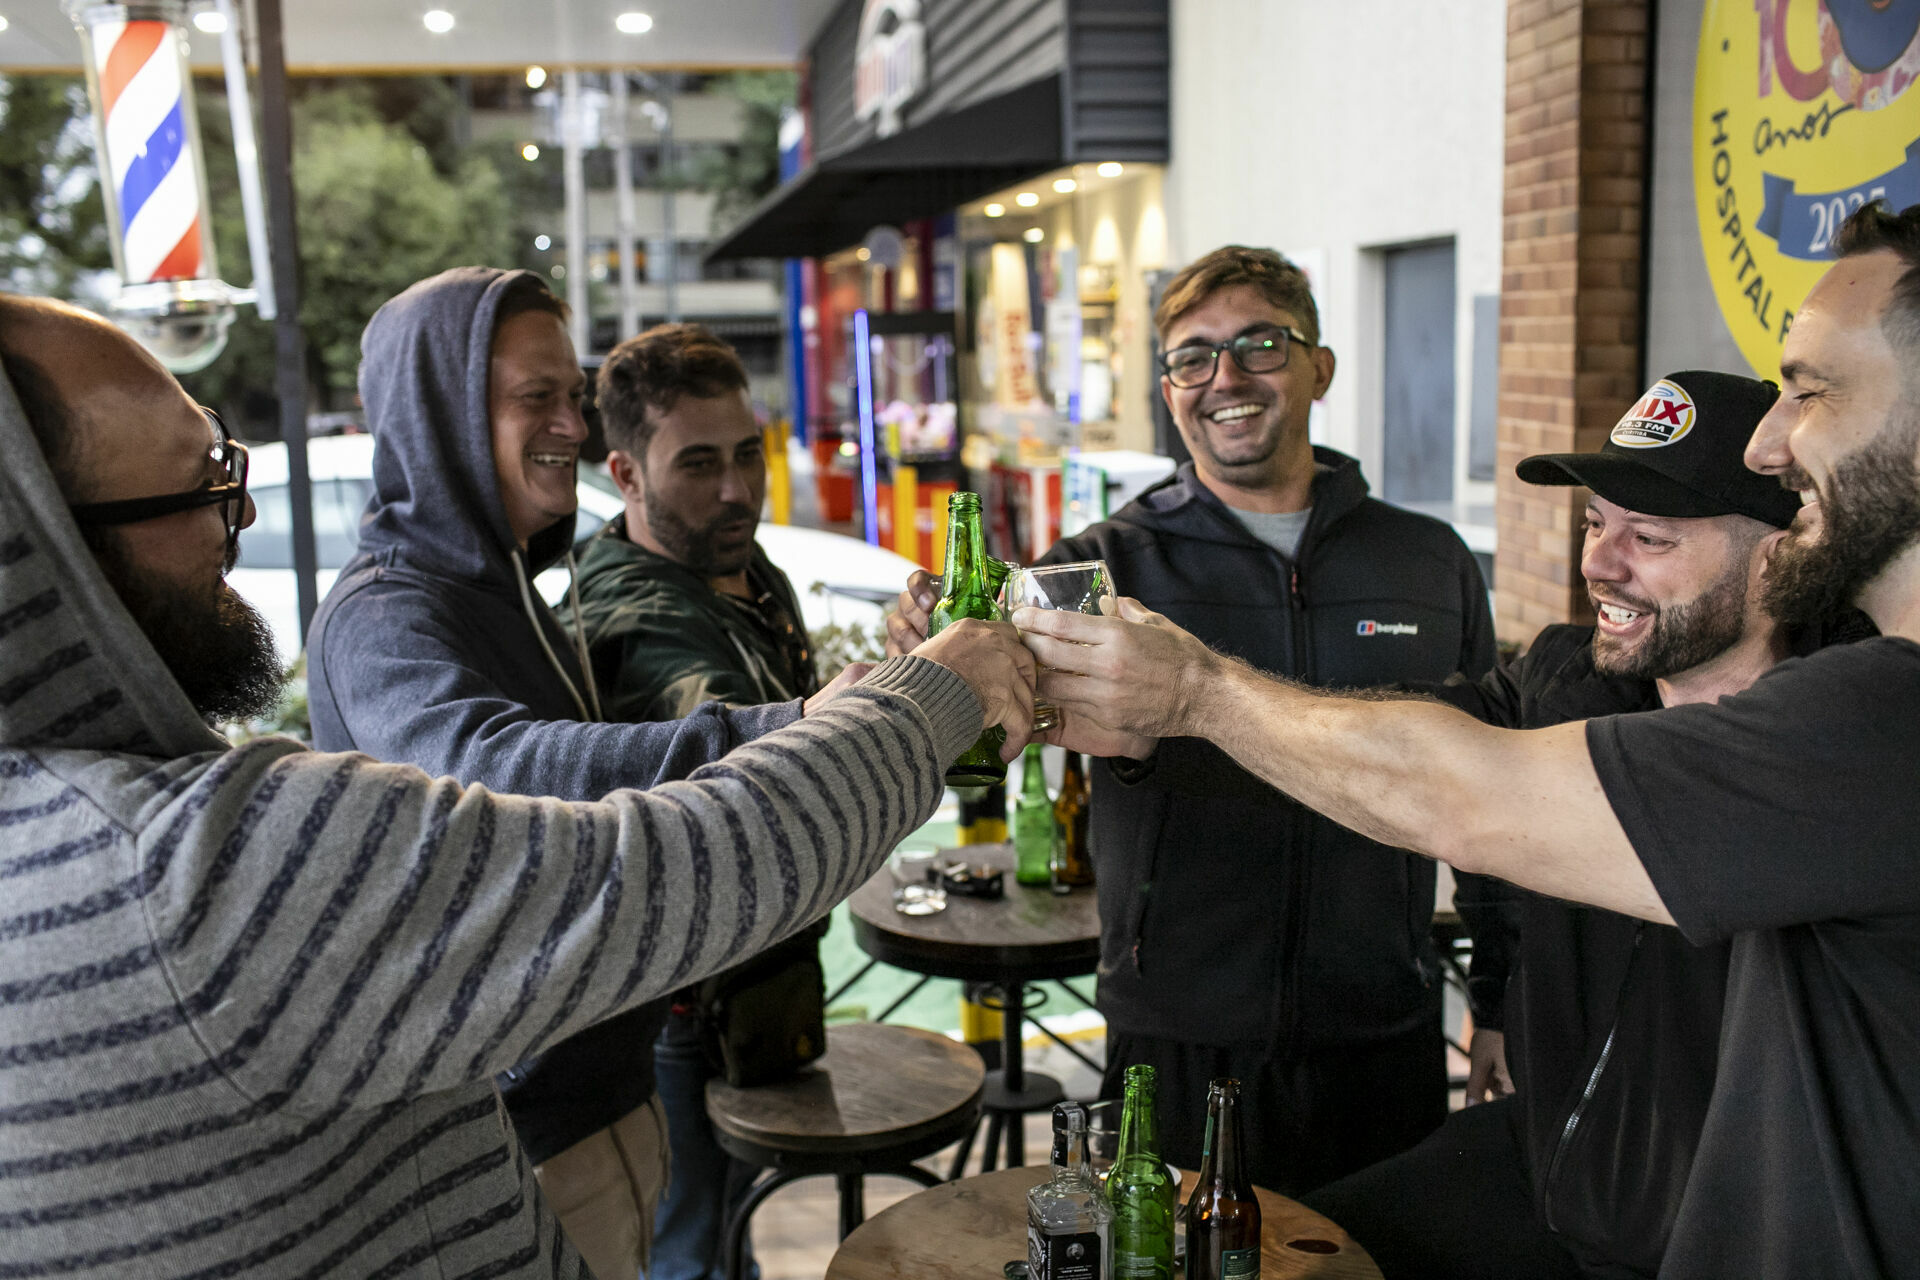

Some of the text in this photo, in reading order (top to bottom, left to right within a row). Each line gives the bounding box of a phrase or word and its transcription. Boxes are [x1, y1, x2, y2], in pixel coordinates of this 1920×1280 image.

[1754, 101, 1855, 155] anos
[1711, 109, 1771, 331] HOSPITAL
[1808, 186, 1886, 254] 20
[1645, 423, 1665, 433] FM
